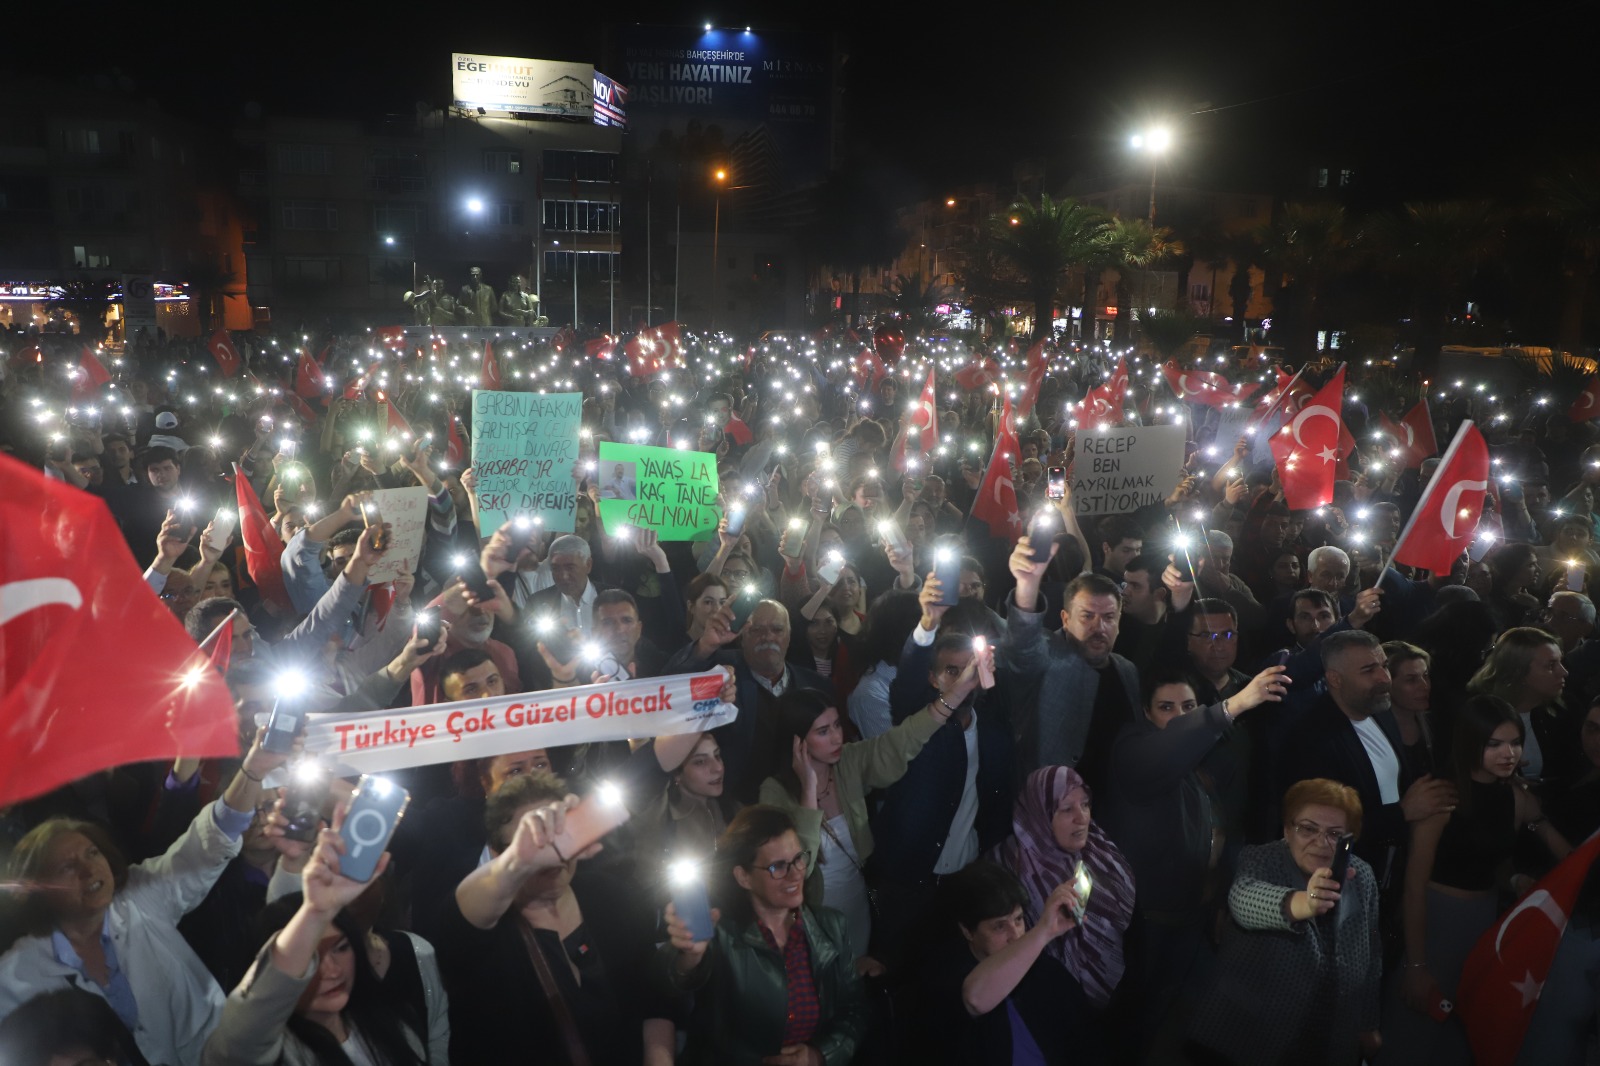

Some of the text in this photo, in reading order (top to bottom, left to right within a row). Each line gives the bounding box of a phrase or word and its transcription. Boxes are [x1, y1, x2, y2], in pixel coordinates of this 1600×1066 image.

[686, 50, 745, 62] BAHÇEŞEHİR'DE
[626, 61, 752, 84] YENİ HAYATINIZ
[628, 84, 713, 107] BAŞLIYOR!
[524, 439, 574, 459] DUVAR
[1083, 435, 1137, 454] RECEP
[640, 457, 711, 482] YAVAŞ LA
[1093, 457, 1120, 473] BEN
[528, 480, 573, 494] MUSUN
[1074, 474, 1155, 492] AYRILMAK
[521, 492, 575, 516] DİRENİŞ
[675, 482, 716, 506] TANE
[334, 684, 673, 752] Türkiye Çok Güzel Olacak
